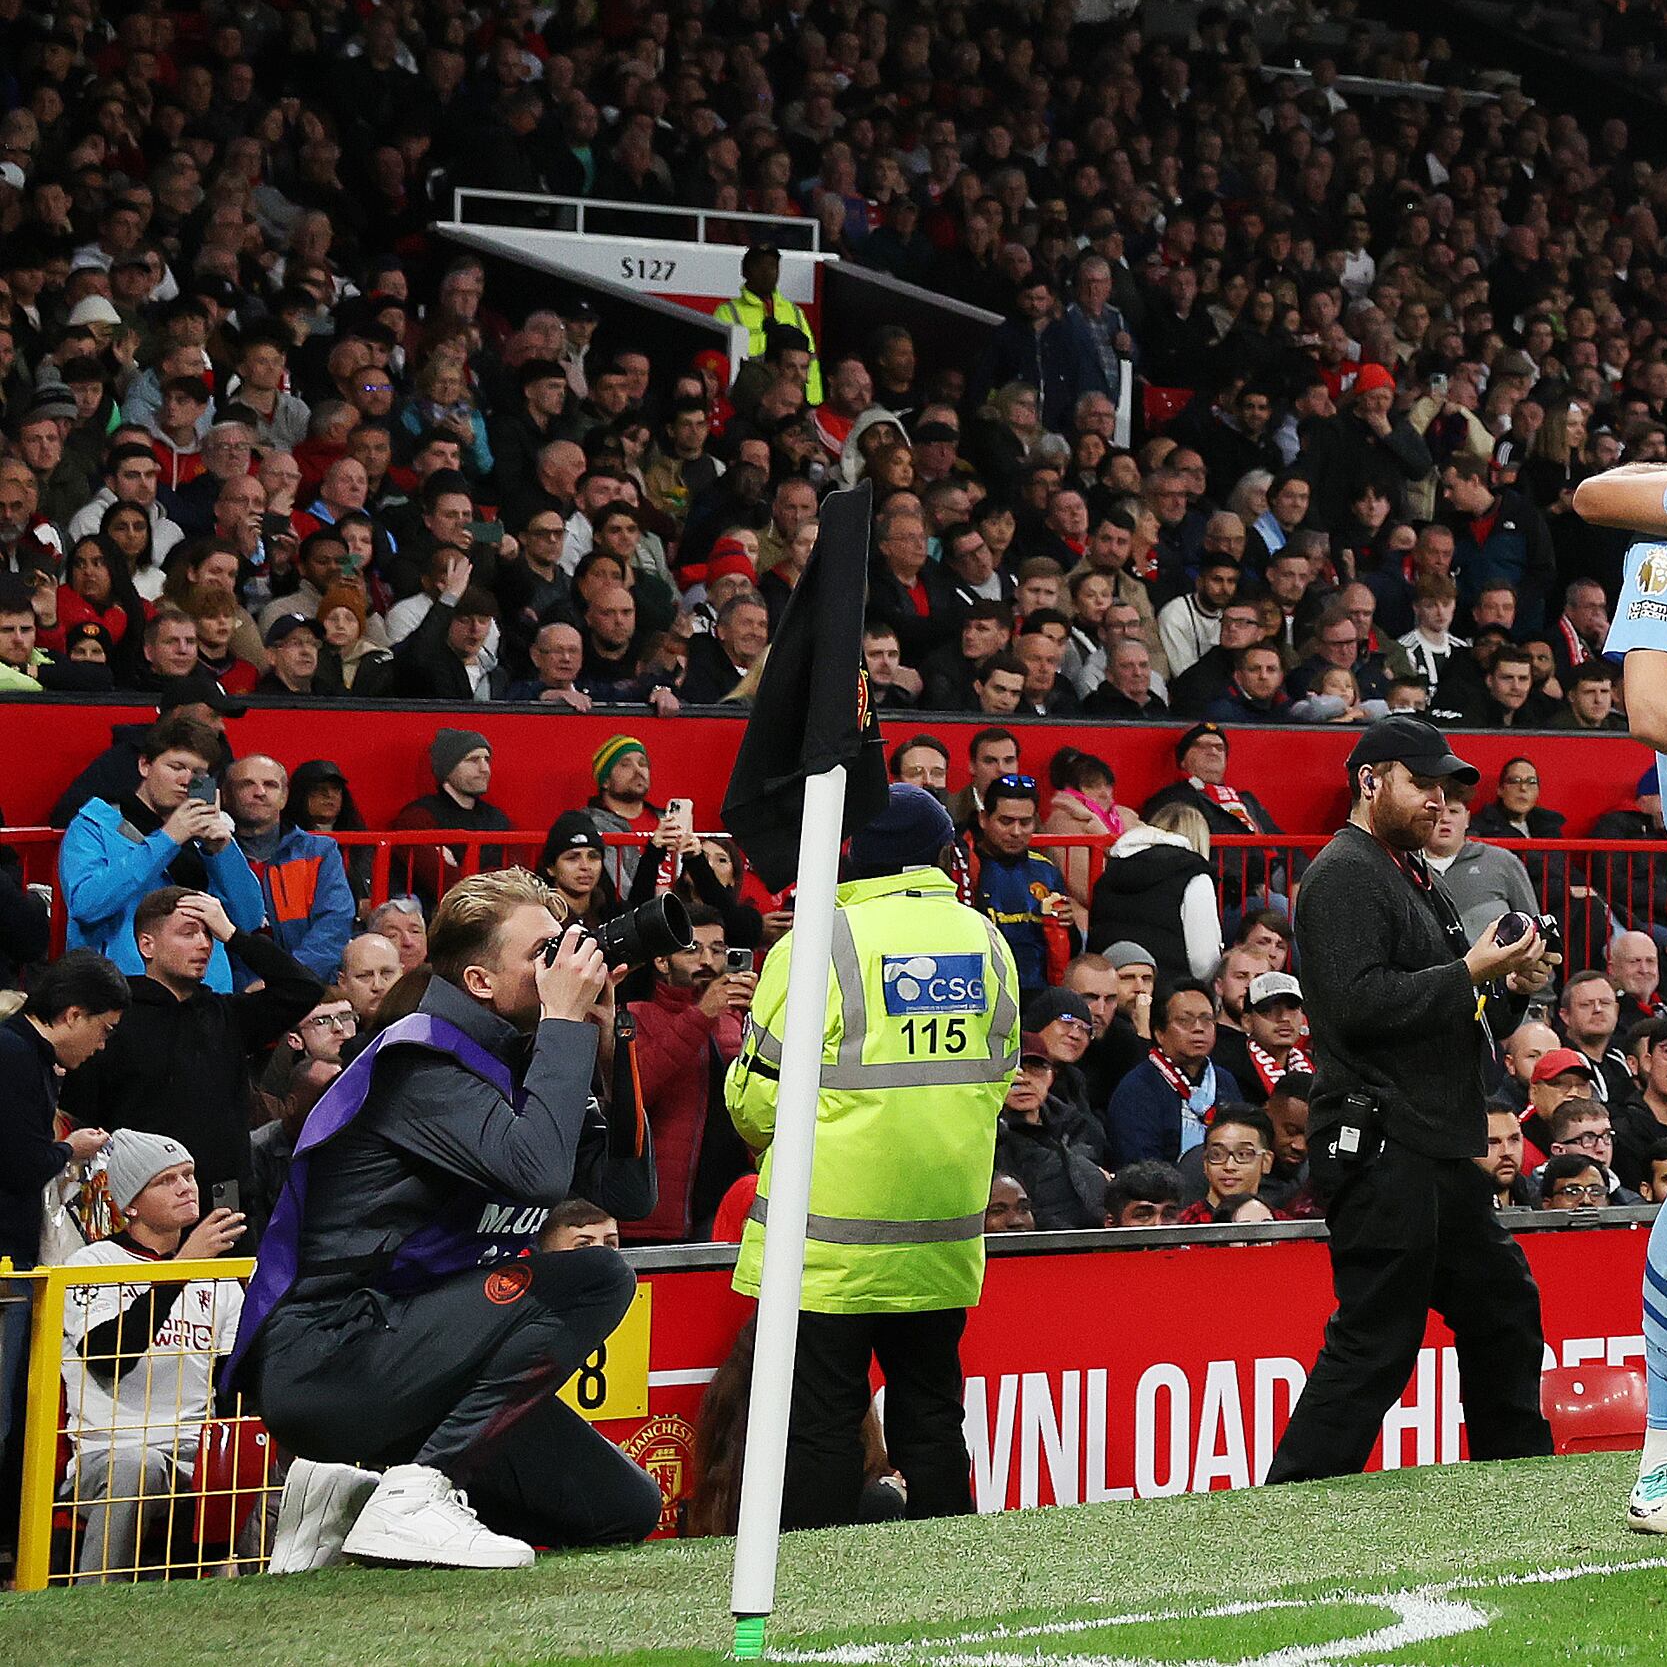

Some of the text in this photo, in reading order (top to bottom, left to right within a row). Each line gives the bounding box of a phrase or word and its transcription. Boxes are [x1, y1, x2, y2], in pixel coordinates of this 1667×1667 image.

[621, 256, 676, 281] S127
[928, 977, 985, 1002] CSG
[901, 1018, 967, 1055] 115
